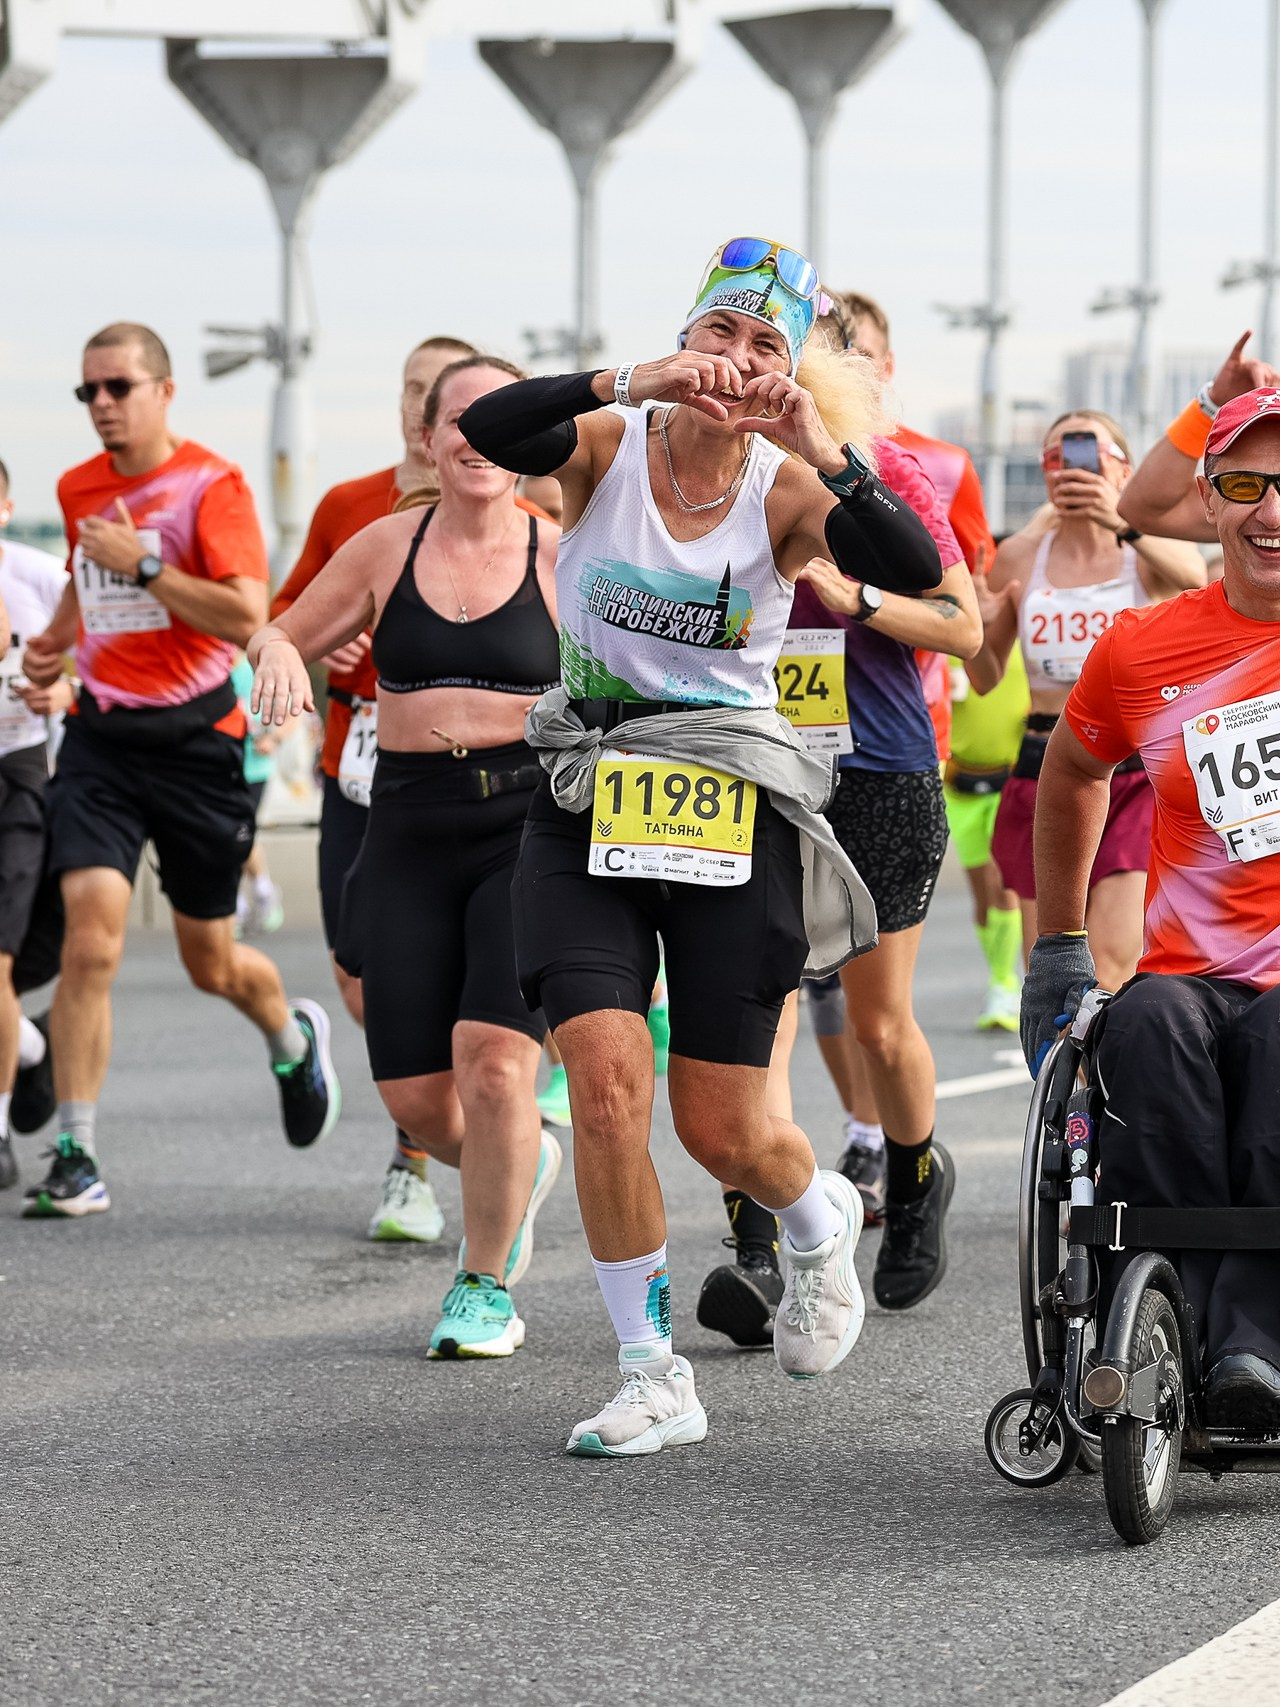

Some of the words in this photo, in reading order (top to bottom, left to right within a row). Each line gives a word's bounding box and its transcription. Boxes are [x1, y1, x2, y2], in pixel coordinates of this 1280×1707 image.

[617, 364, 633, 386] 11981
[882, 498, 899, 513] FIT
[592, 575, 722, 628] #ГАТЧИНСКИЕ
[588, 598, 717, 646] #ПРОБЕЖКИ
[1031, 612, 1121, 645] 2133
[429, 676, 473, 686] UNDER
[493, 682, 542, 693] ARMOUR
[1221, 700, 1265, 716] СБЕРПРАЙМ
[1225, 714, 1269, 731] МАРАФОН
[604, 770, 746, 825] 11981
[645, 822, 704, 838] ТАТЬЯНА
[736, 834, 743, 842] 2
[1226, 828, 1244, 857] F
[604, 847, 626, 872] C
